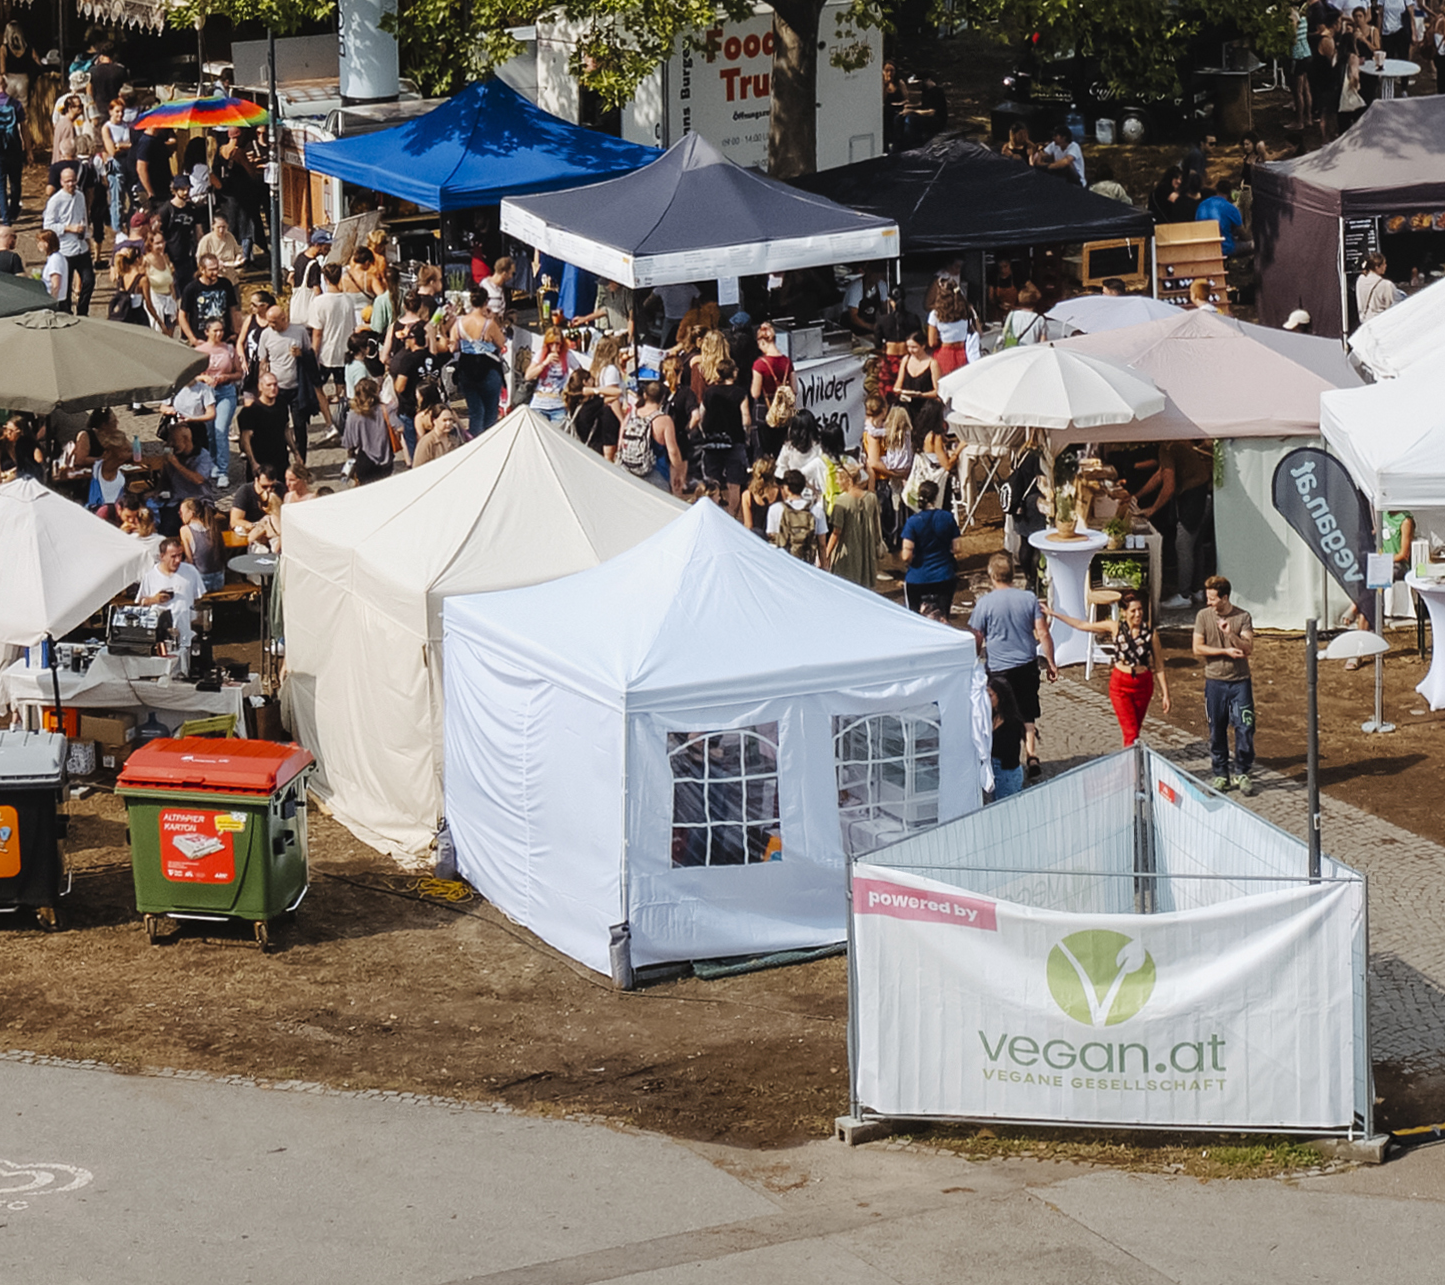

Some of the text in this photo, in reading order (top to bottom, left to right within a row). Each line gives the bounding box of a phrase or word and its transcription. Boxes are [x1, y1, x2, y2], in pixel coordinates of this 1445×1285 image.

[680, 44, 693, 100] Burge
[719, 67, 770, 102] Tru
[798, 373, 856, 408] Wilder
[163, 812, 206, 824] ALTPAPIER
[163, 823, 197, 833] KARTON
[867, 887, 979, 923] powered by
[977, 1028, 1229, 1075] vegan.at
[982, 1067, 1228, 1093] VEGANE GESELLSCHAFT
